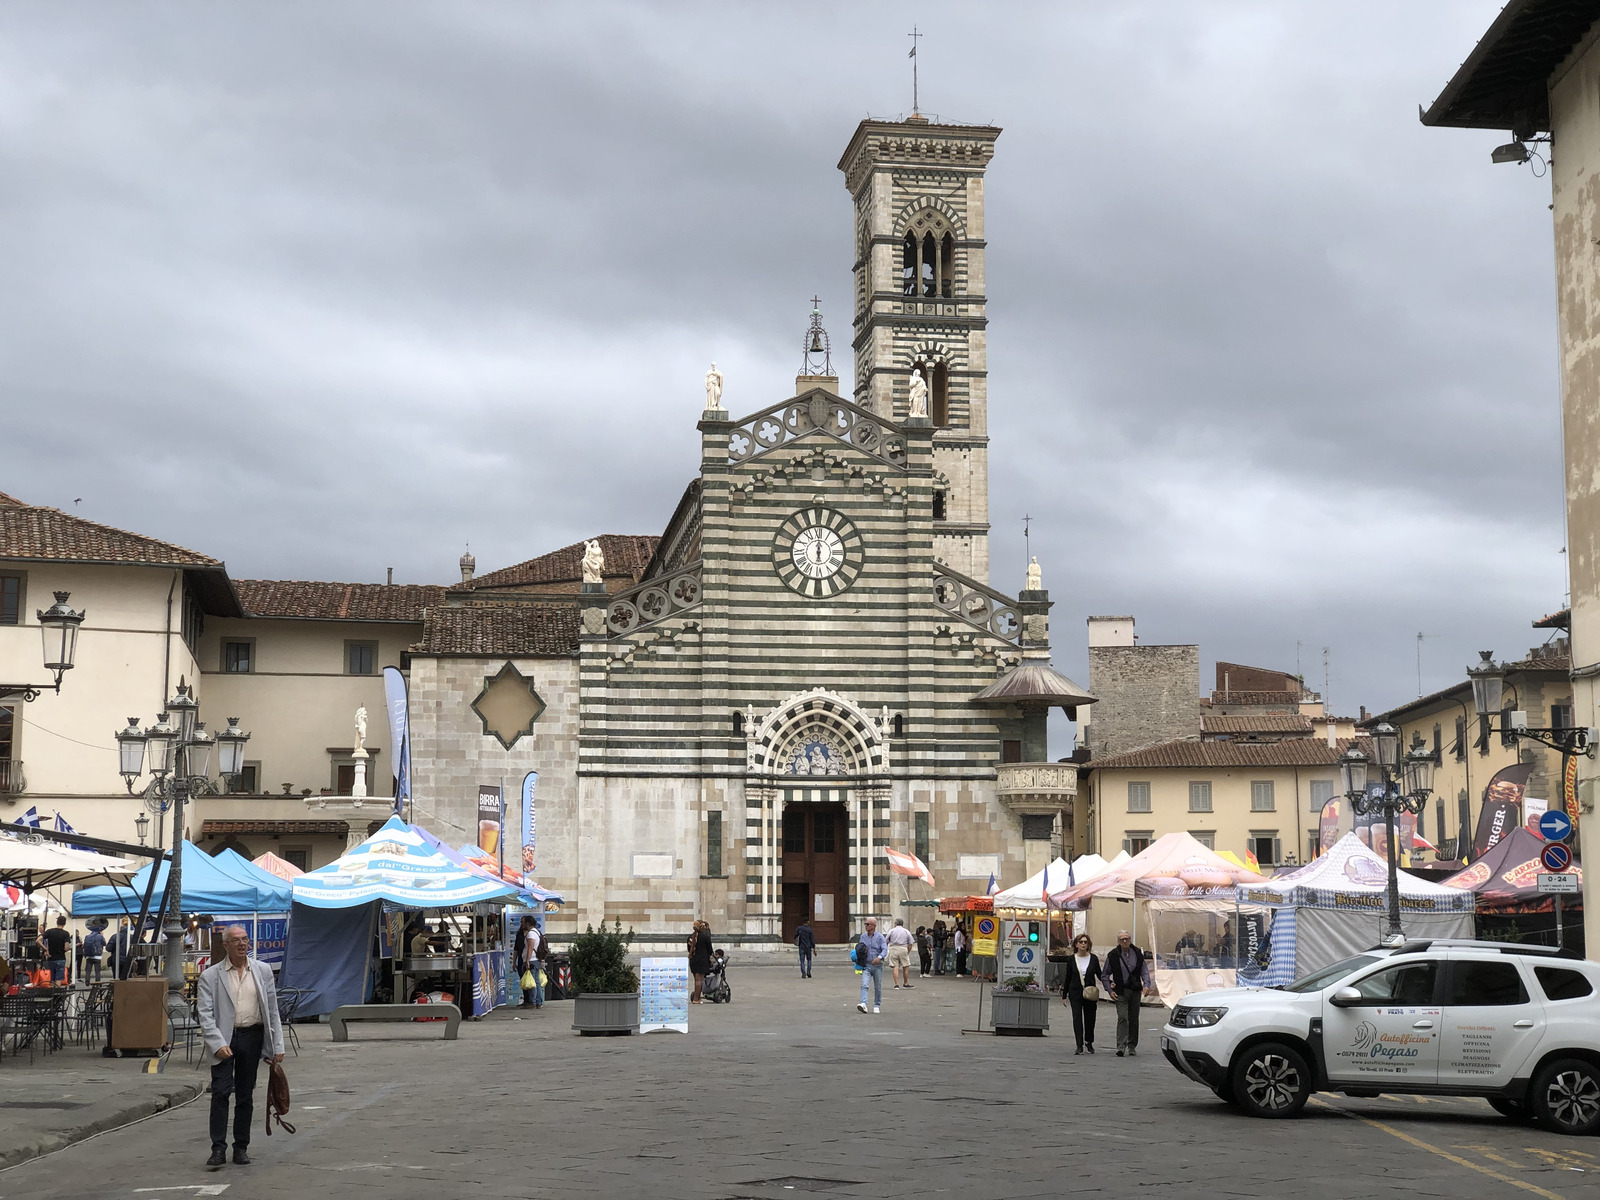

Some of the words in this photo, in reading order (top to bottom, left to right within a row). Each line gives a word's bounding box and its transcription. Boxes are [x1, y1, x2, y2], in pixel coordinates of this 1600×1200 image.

[480, 794, 500, 806] BIRRA
[1335, 893, 1383, 907] Birrificio
[1380, 1033, 1430, 1044] Autofficina
[1370, 1043, 1418, 1059] Pegaso
